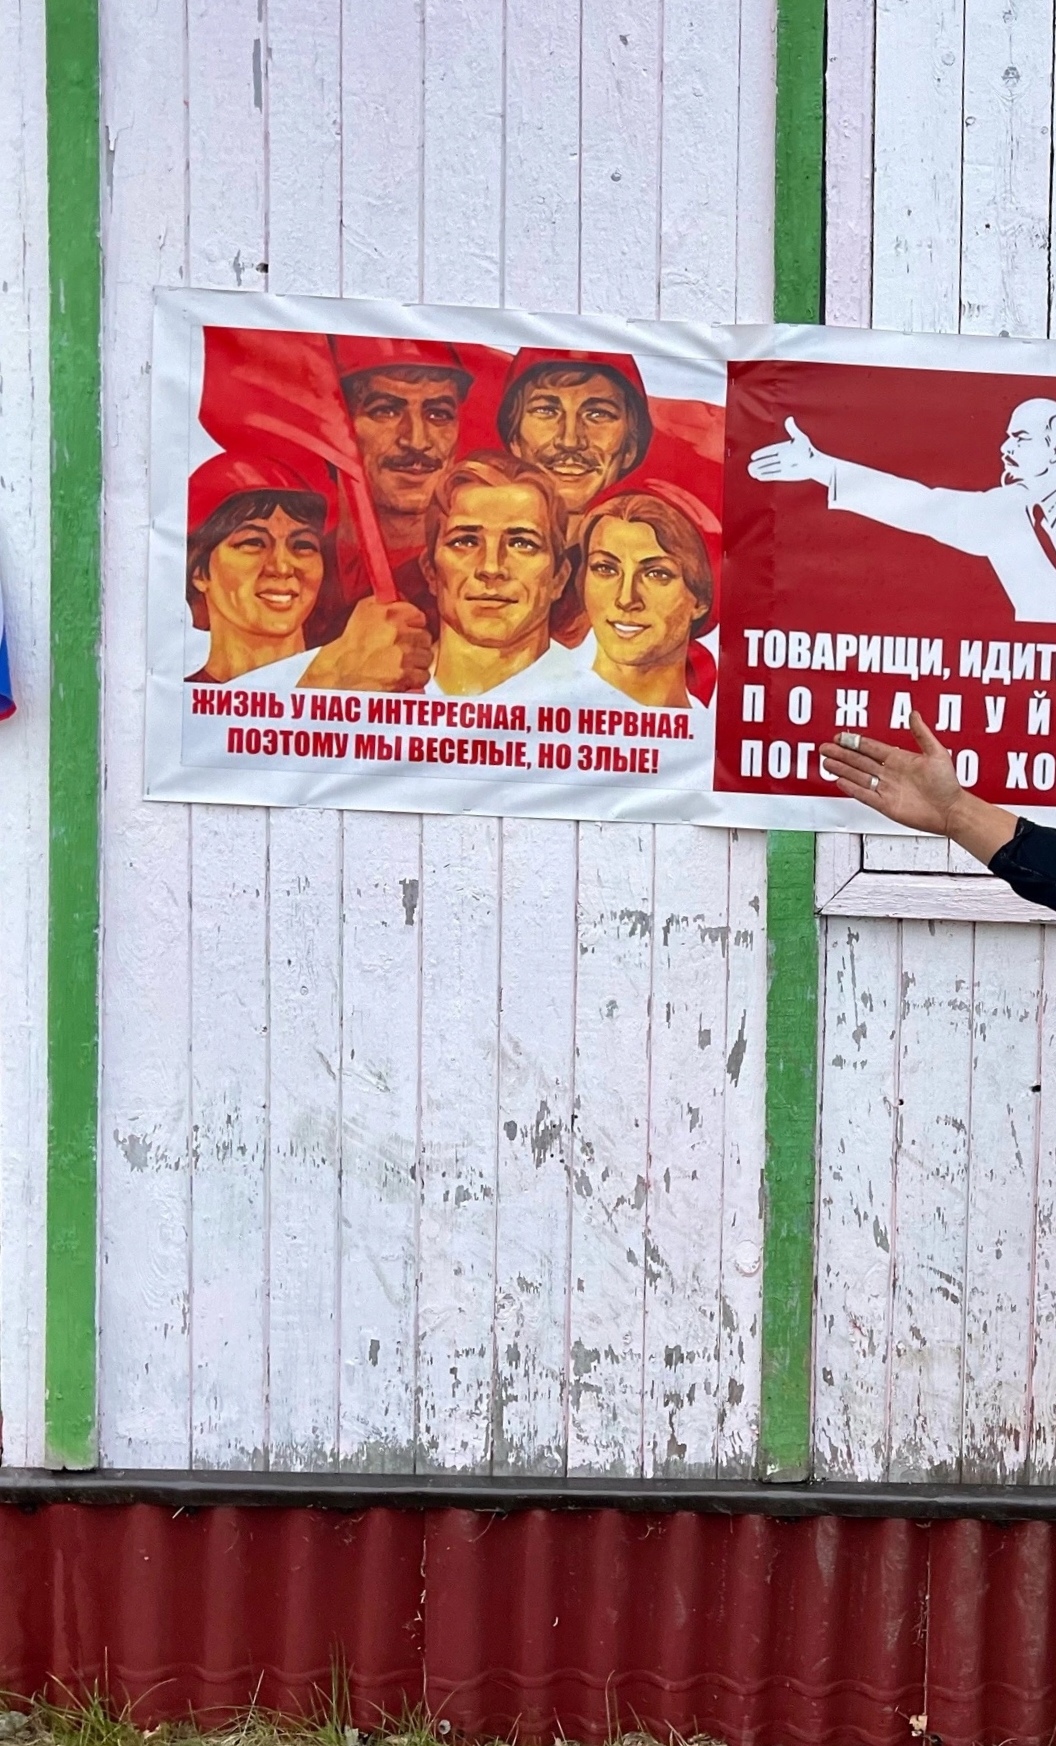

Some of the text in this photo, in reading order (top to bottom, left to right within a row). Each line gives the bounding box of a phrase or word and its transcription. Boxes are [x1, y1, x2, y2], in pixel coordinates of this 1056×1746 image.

[743, 628, 951, 681] ТОВАРИЩИ,
[191, 688, 695, 740] ЖИЗНЬ У НАС ИНТЕРЕСНАЯ, НО НЕРВНАЯ.
[227, 727, 660, 774] ПОЭТОМУ МЫ ВЕСЕЛЫЕ, НО ЗЛЫЕ!
